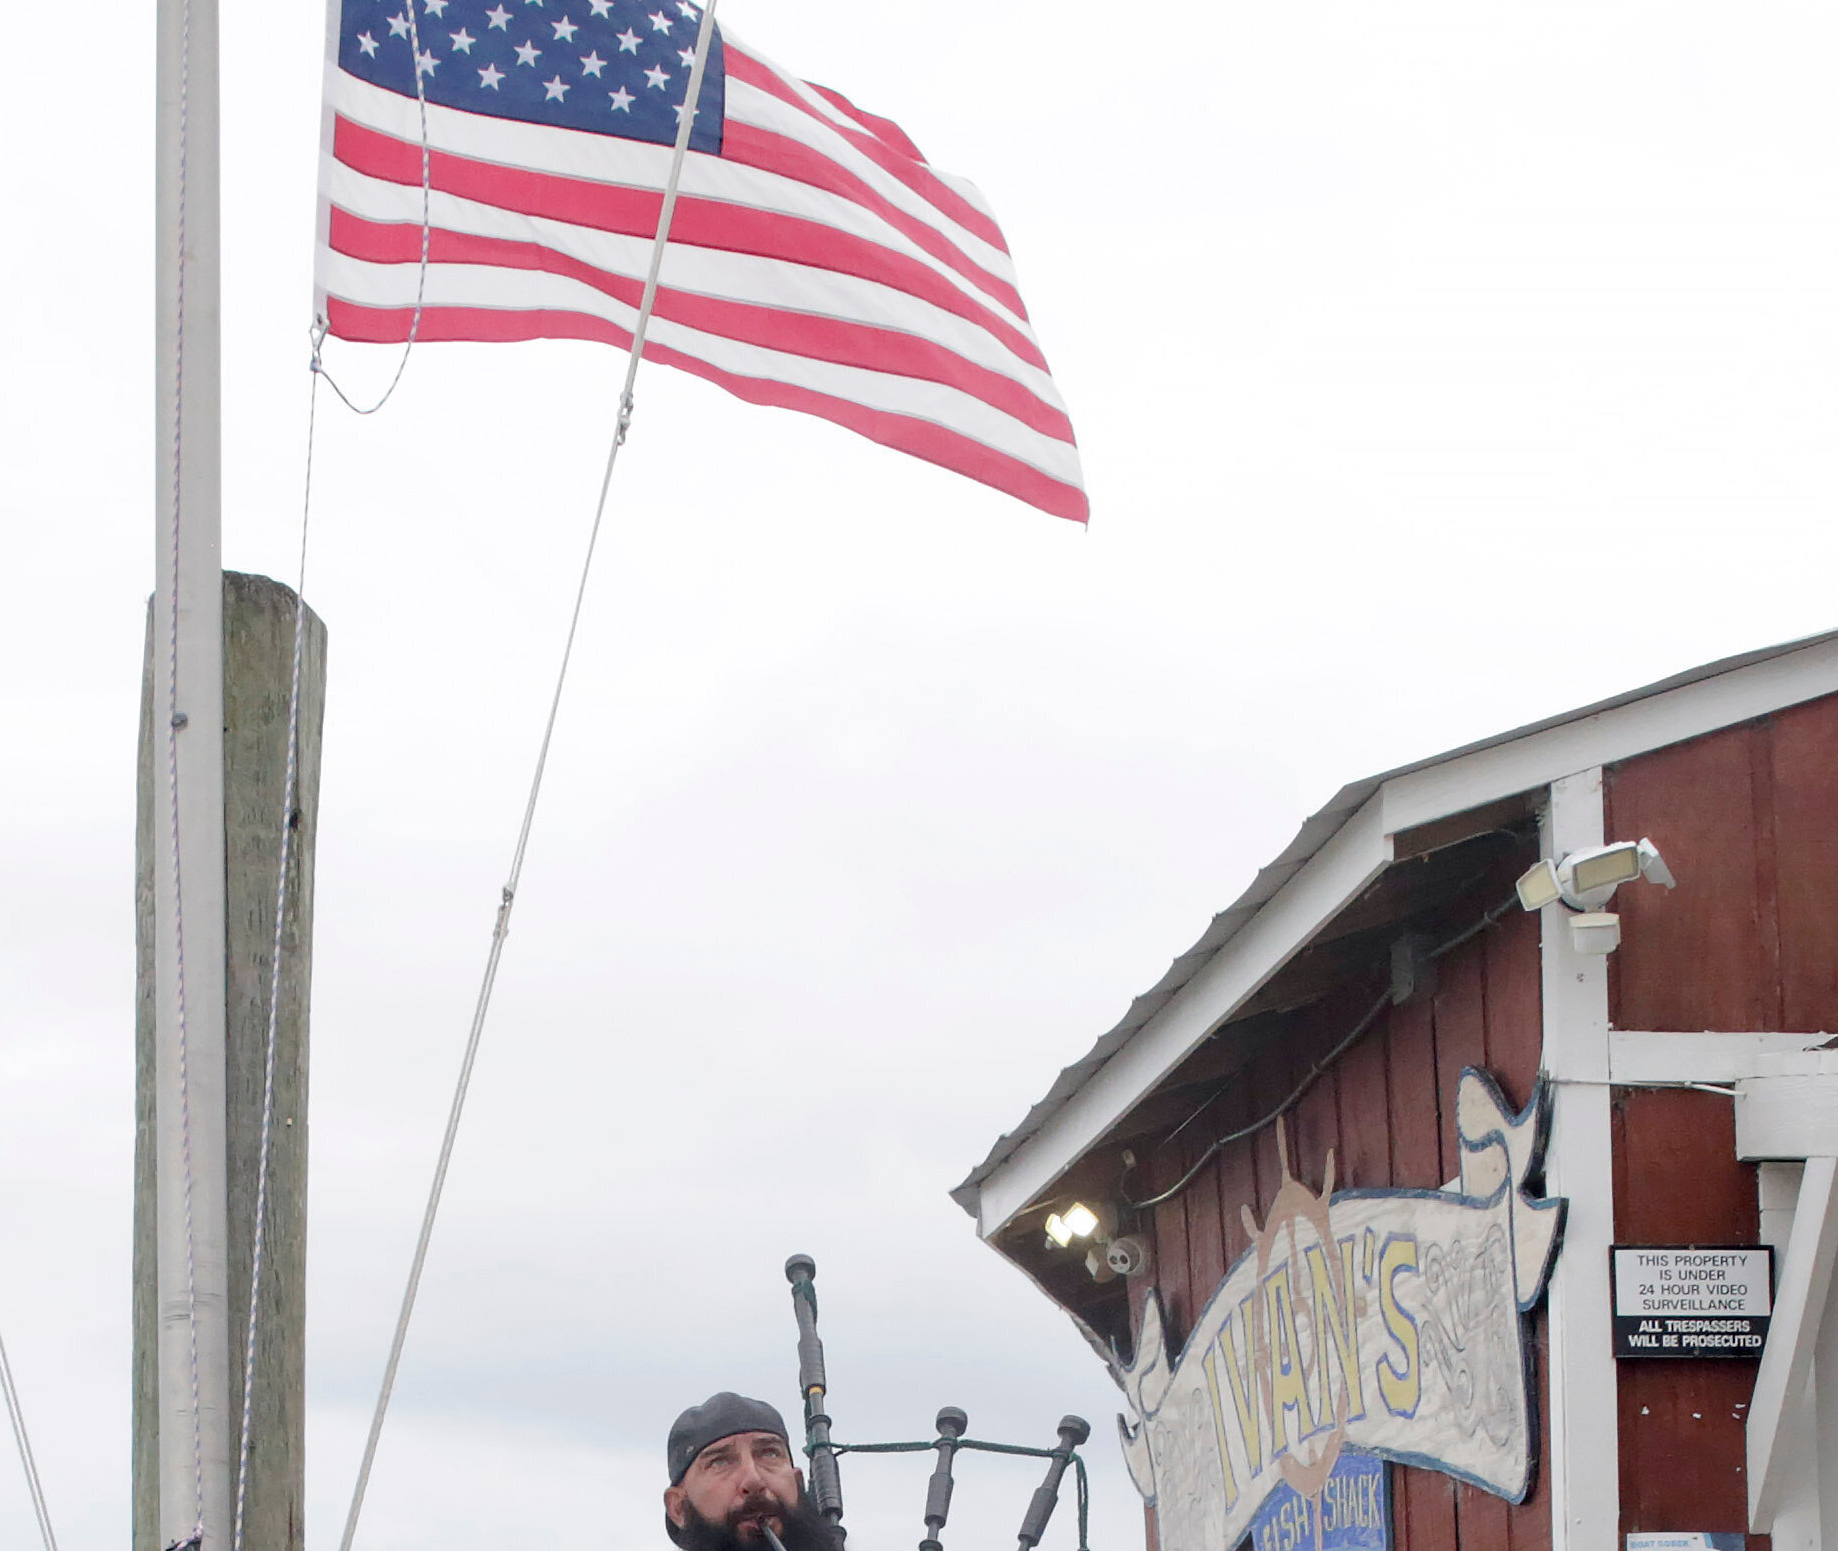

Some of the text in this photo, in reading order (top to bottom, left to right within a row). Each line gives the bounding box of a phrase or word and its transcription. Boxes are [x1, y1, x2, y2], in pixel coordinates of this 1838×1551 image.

[1637, 1255, 1748, 1267] THIS PROPERTY
[1659, 1270, 1726, 1281] IS UNDER
[1639, 1284, 1748, 1296] 24 HOUR VIDEO
[1643, 1299, 1745, 1311] SURVEILLANCE
[1639, 1320, 1750, 1333] ALL TRESPASSERS
[1628, 1335, 1762, 1348] WILL BE PROSECUTED
[1203, 1227, 1421, 1513] IVAN'S
[1323, 1473, 1381, 1531] SHACK
